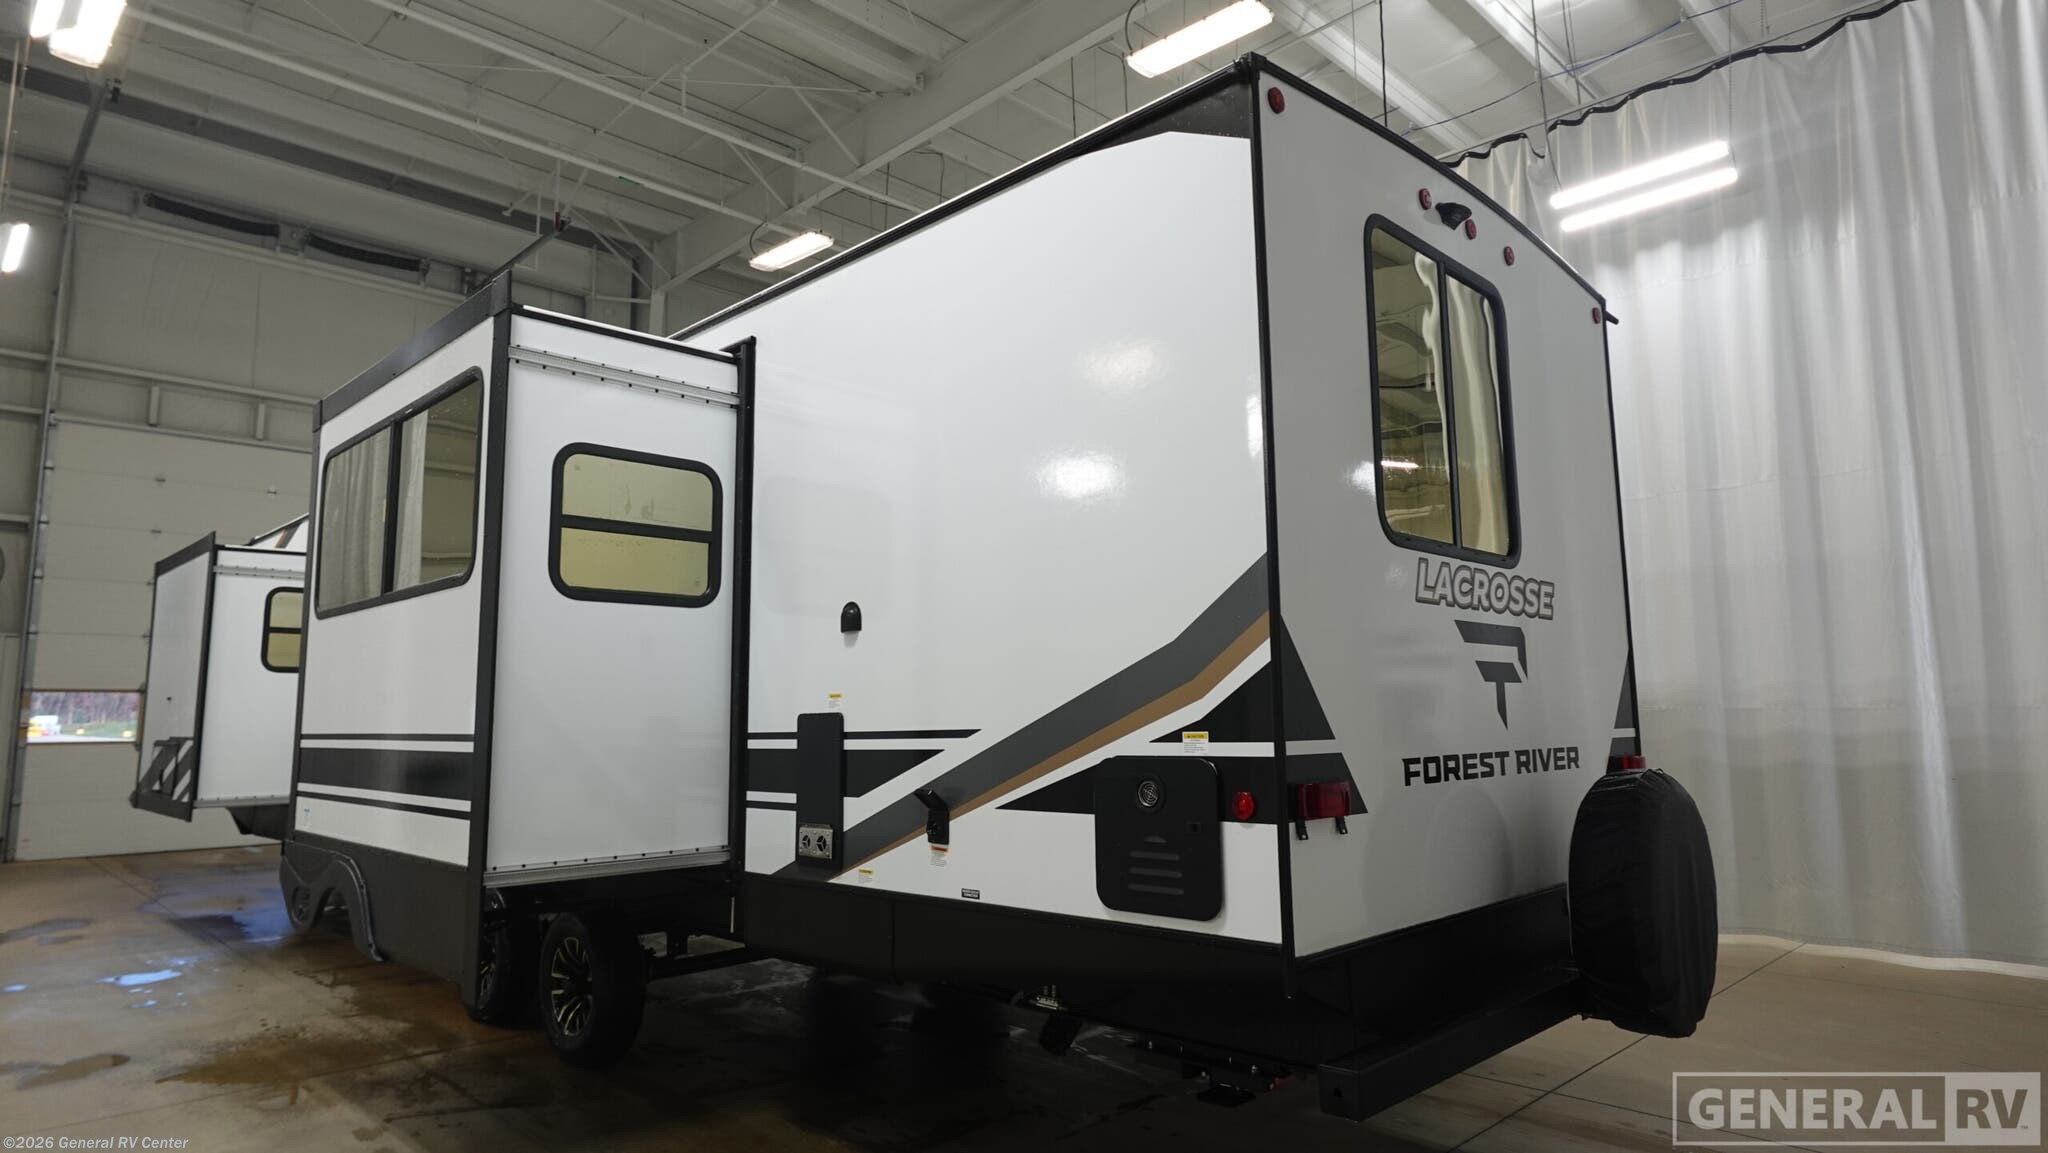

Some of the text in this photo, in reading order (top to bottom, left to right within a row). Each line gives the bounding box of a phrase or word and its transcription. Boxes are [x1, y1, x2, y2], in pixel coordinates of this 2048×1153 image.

[1415, 557, 1555, 620] LACROSSE
[1401, 746, 1580, 786] FOREST RIVER
